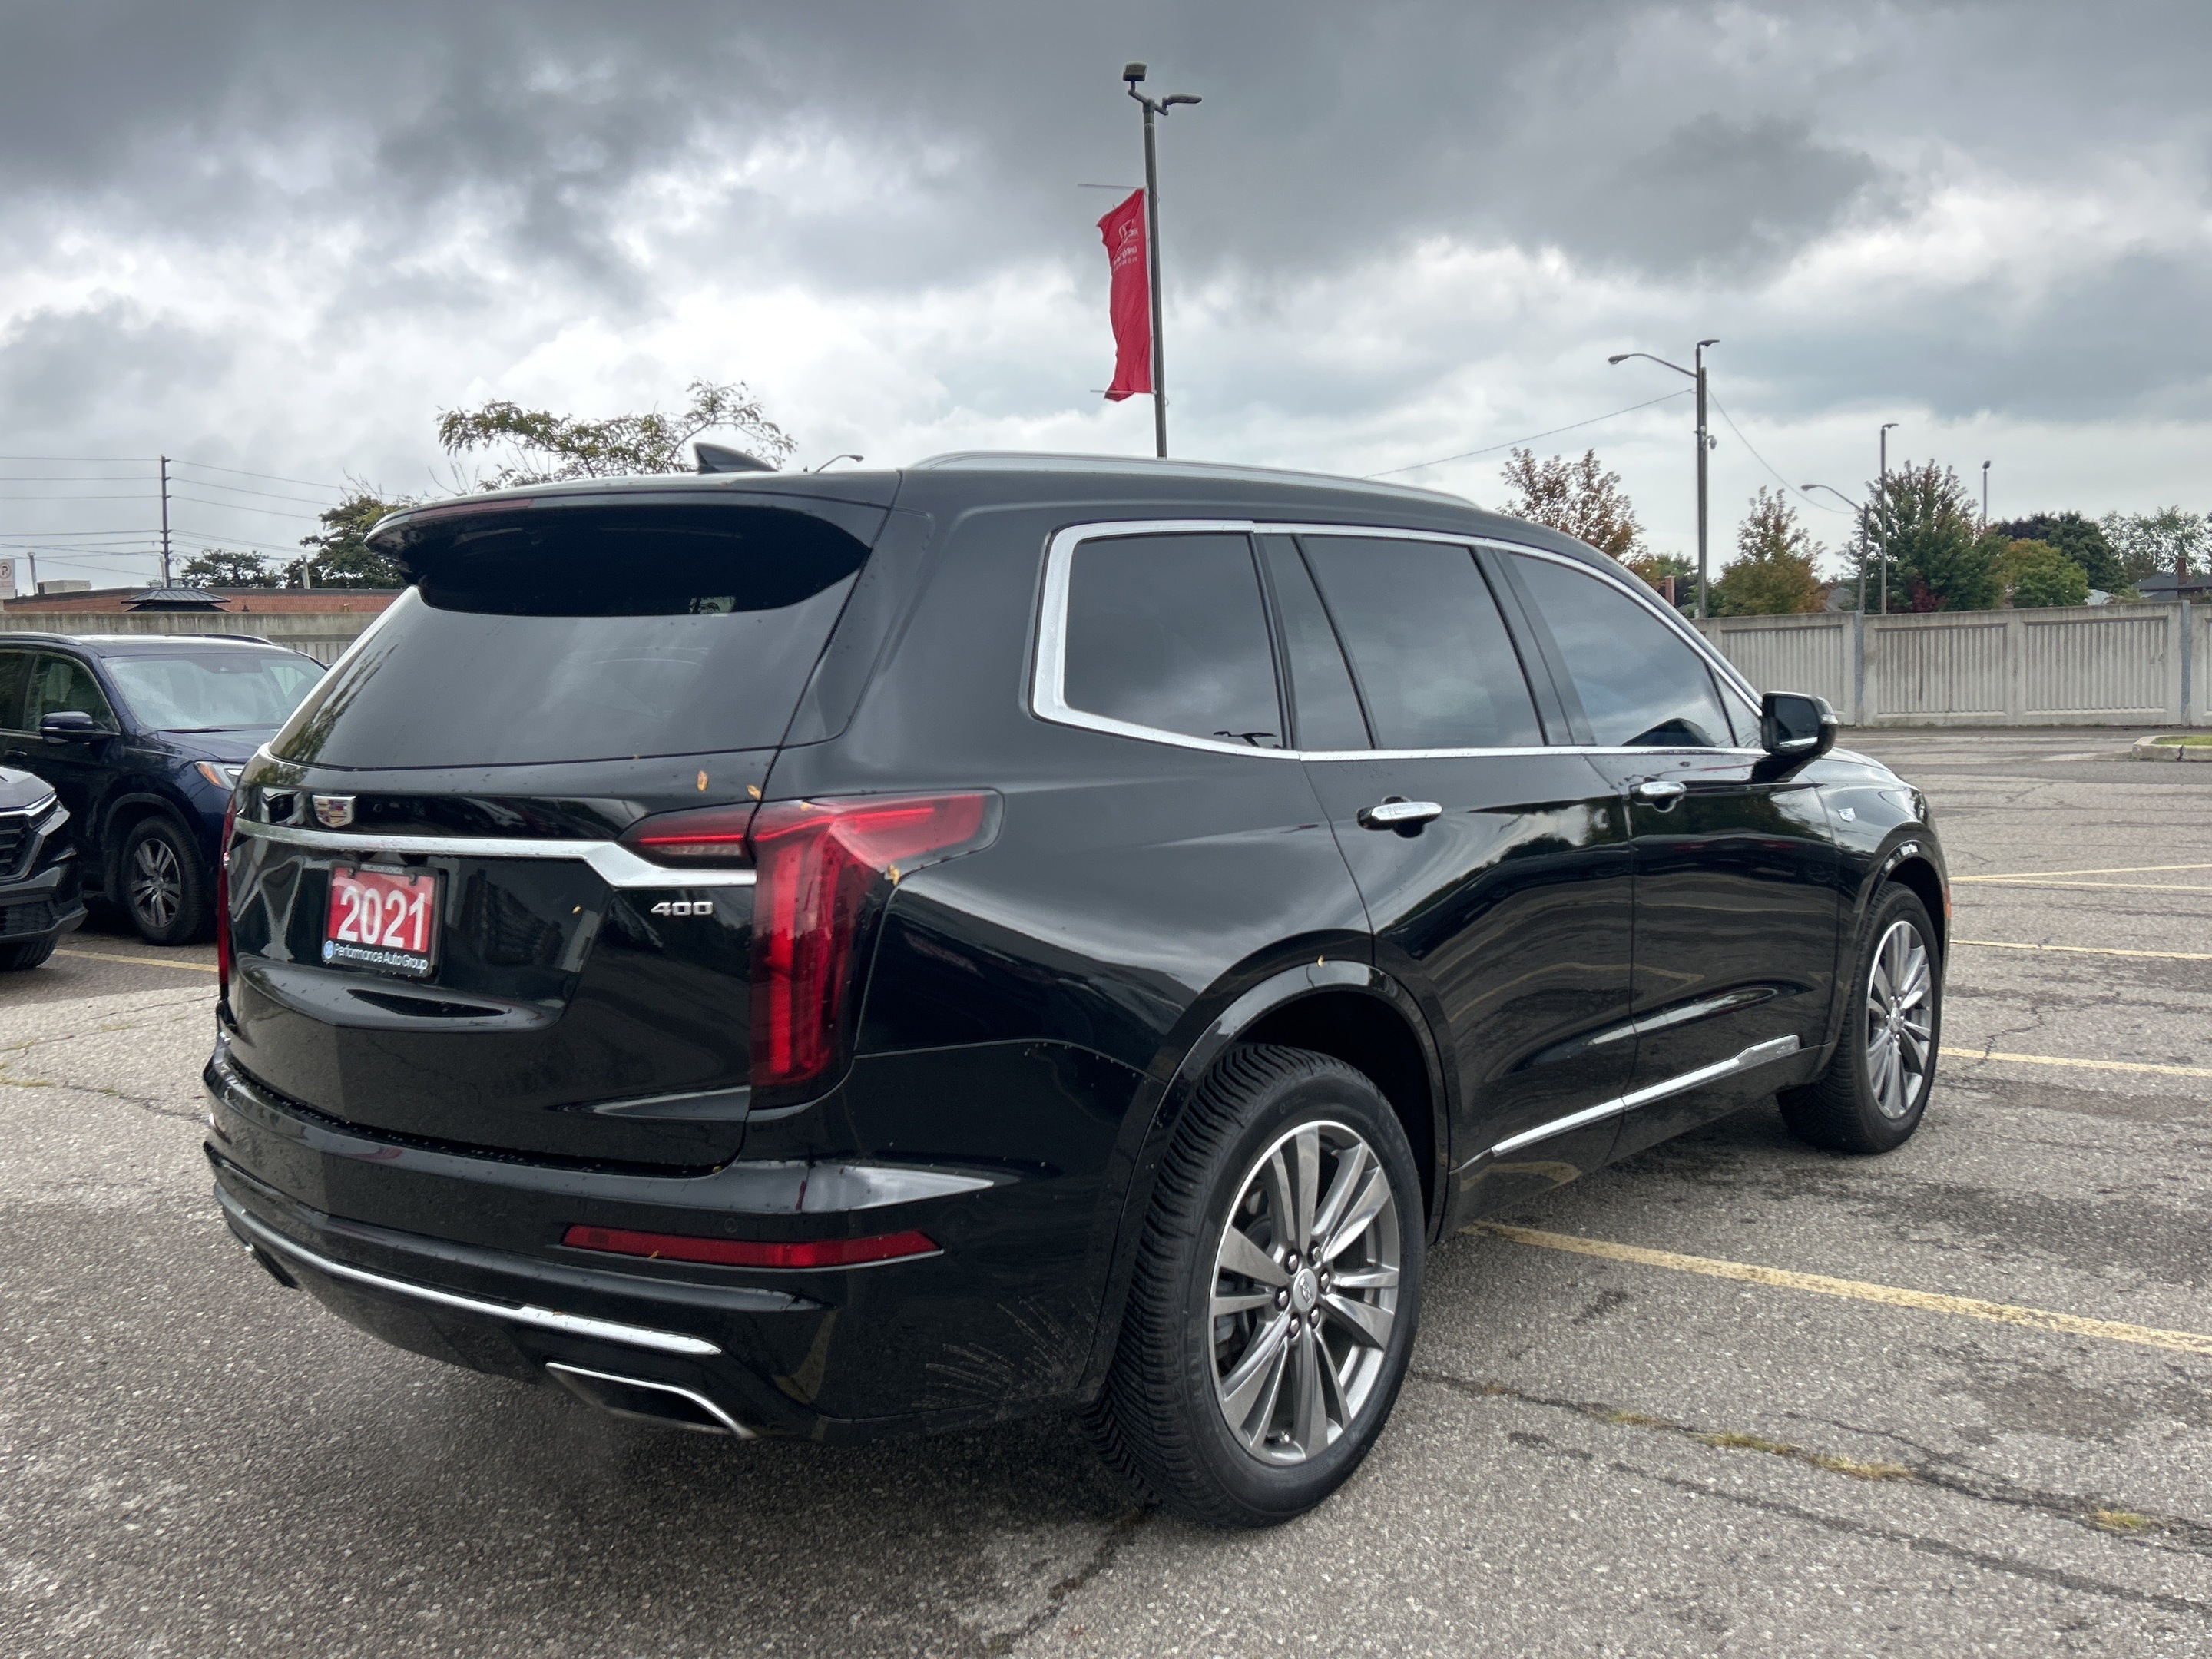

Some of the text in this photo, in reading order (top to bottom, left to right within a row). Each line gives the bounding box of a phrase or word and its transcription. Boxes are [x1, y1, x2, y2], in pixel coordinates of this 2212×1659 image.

[336, 886, 426, 951] 2021
[650, 901, 714, 916] 400
[334, 943, 429, 974] Performance Auto Group
